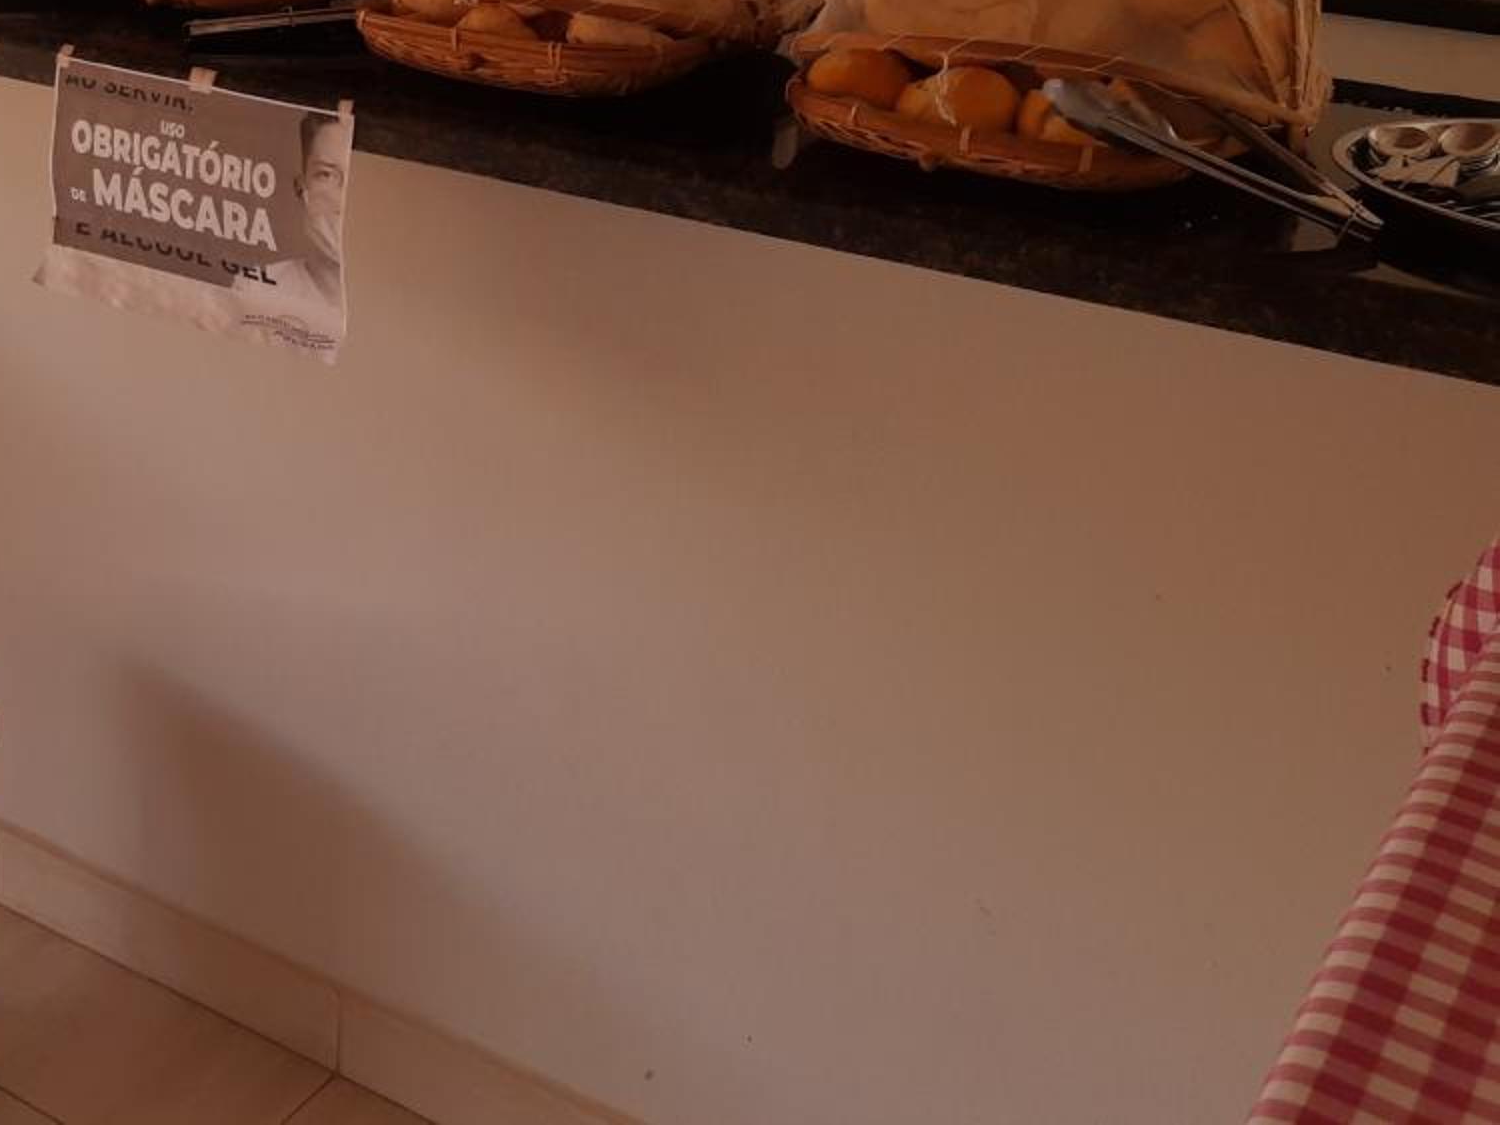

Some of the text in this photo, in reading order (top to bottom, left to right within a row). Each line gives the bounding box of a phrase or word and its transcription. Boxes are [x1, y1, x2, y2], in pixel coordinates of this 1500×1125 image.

[71, 119, 277, 199] OBRIGATÓRIO
[160, 120, 186, 140] USO
[92, 166, 278, 252] MÁSCARA
